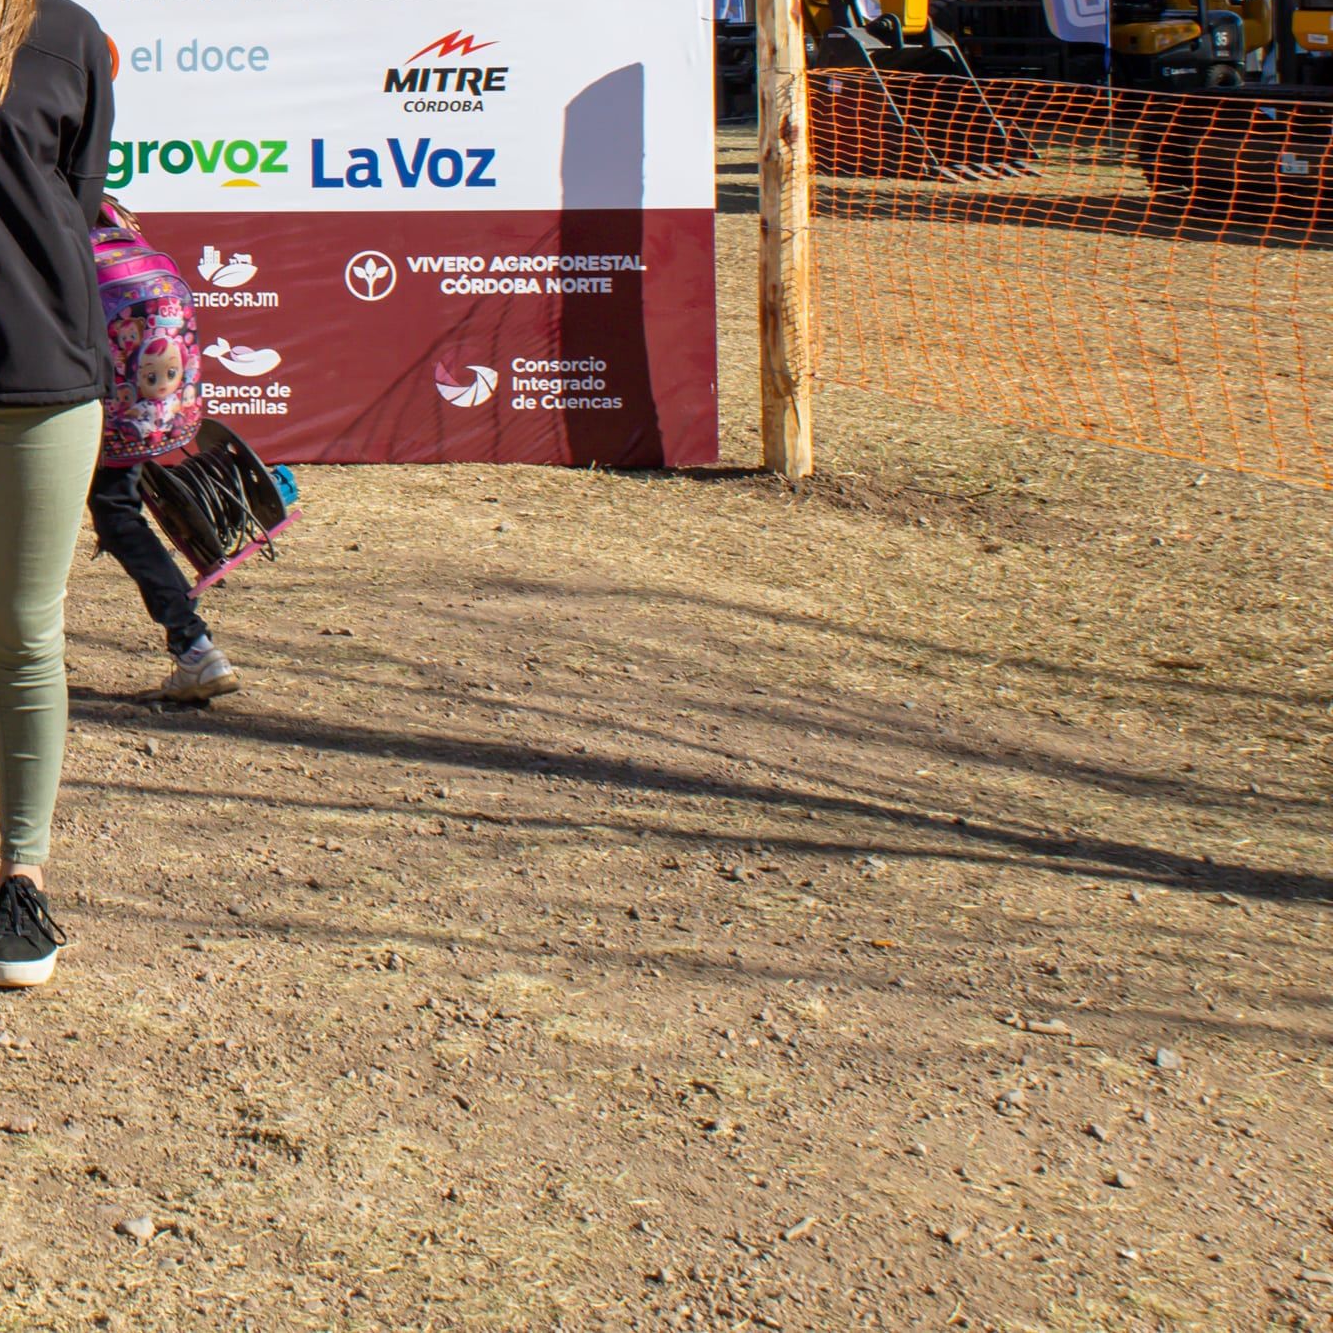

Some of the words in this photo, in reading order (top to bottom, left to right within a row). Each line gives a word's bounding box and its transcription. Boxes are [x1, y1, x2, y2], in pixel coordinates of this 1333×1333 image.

[131, 39, 162, 72] el
[176, 38, 269, 72] doce
[384, 67, 509, 96] MITRE
[403, 98, 484, 113] CÓRDOBA
[104, 139, 288, 189] grovoz
[406, 256, 485, 273] VIVERO
[489, 255, 647, 272] AGROFORESTAL
[440, 274, 542, 295] CÓRDOBA
[546, 277, 612, 294] NORTE
[511, 357, 606, 374] Consorcio
[201, 383, 262, 398] Banco
[266, 382, 291, 397] de
[511, 375, 605, 394] Integrado
[207, 399, 288, 415] Semillas
[511, 395, 537, 410] de
[541, 395, 623, 410] Cuencas
